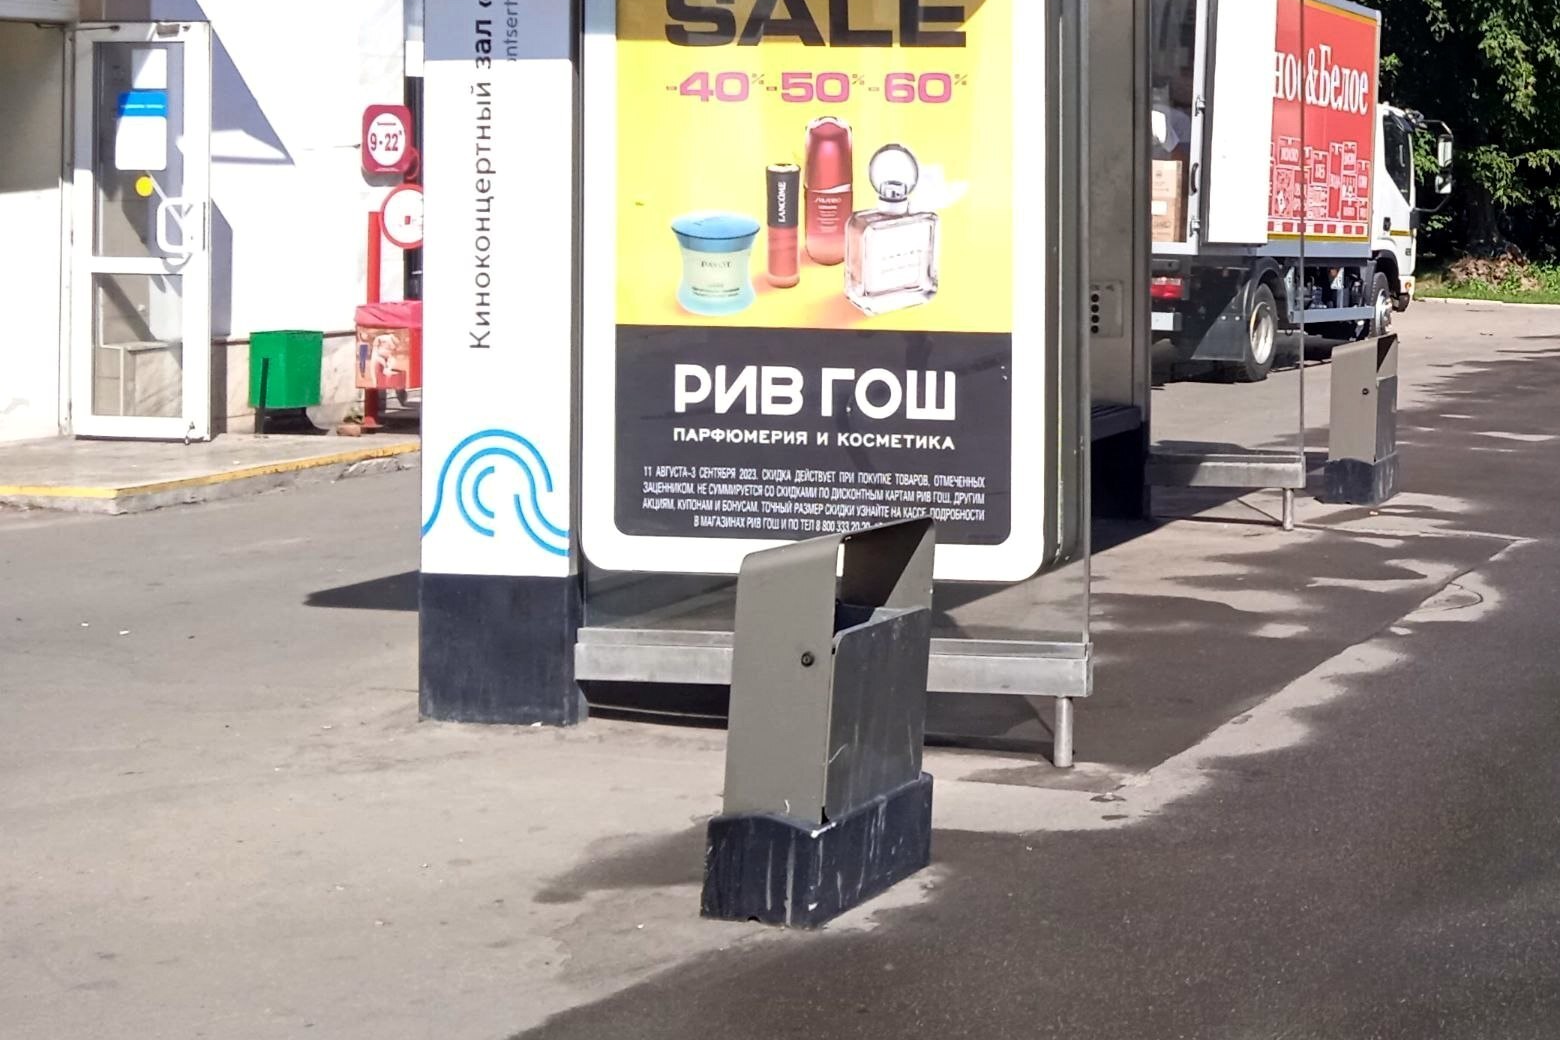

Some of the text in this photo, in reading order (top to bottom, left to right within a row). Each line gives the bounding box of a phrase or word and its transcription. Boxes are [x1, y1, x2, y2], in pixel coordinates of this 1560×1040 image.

[475, 19, 491, 69] зал
[469, 82, 496, 349] Киноконцертный
[674, 364, 956, 420] РИВ ГОШ
[673, 427, 955, 450] ПАРФЮМЕРИЯ И КОСМЕТИКА
[699, 467, 736, 479] СЕНТЯБРЯ
[762, 469, 791, 482] СКИДКА
[794, 468, 836, 483] ДЕЙСТВУЕТ
[839, 472, 854, 483] ПРИ
[858, 473, 892, 485] ПОКУПКЕ
[934, 475, 985, 488] ОТМЕЧЕННЫХ
[697, 483, 706, 494] НЕ
[708, 483, 762, 496] СУММИРУЕТСЯ
[764, 485, 774, 497] СО
[777, 486, 817, 498] СКИДКАМИ
[819, 487, 829, 498] ПО
[831, 488, 883, 501] ДИСКОНТНЫМ
[885, 490, 915, 502] КАРТАМ
[916, 491, 930, 503] РИВ
[953, 492, 985, 505] ДРУГИМ
[677, 499, 712, 511] КУПОНАМ
[714, 500, 721, 511] И
[761, 501, 791, 513] ТОЧНЫЙ
[794, 503, 823, 515] РАЗМЕР
[825, 504, 854, 517] СКИДКИ
[856, 504, 889, 517] УЗНАЙТЕ
[891, 506, 901, 518] НА
[694, 515, 699, 527] В
[701, 515, 745, 528] МАГАЗИНАХ
[747, 517, 761, 529] РИВ
[763, 518, 779, 529] ГОШ
[781, 518, 787, 529] И
[788, 519, 799, 530] ПО
